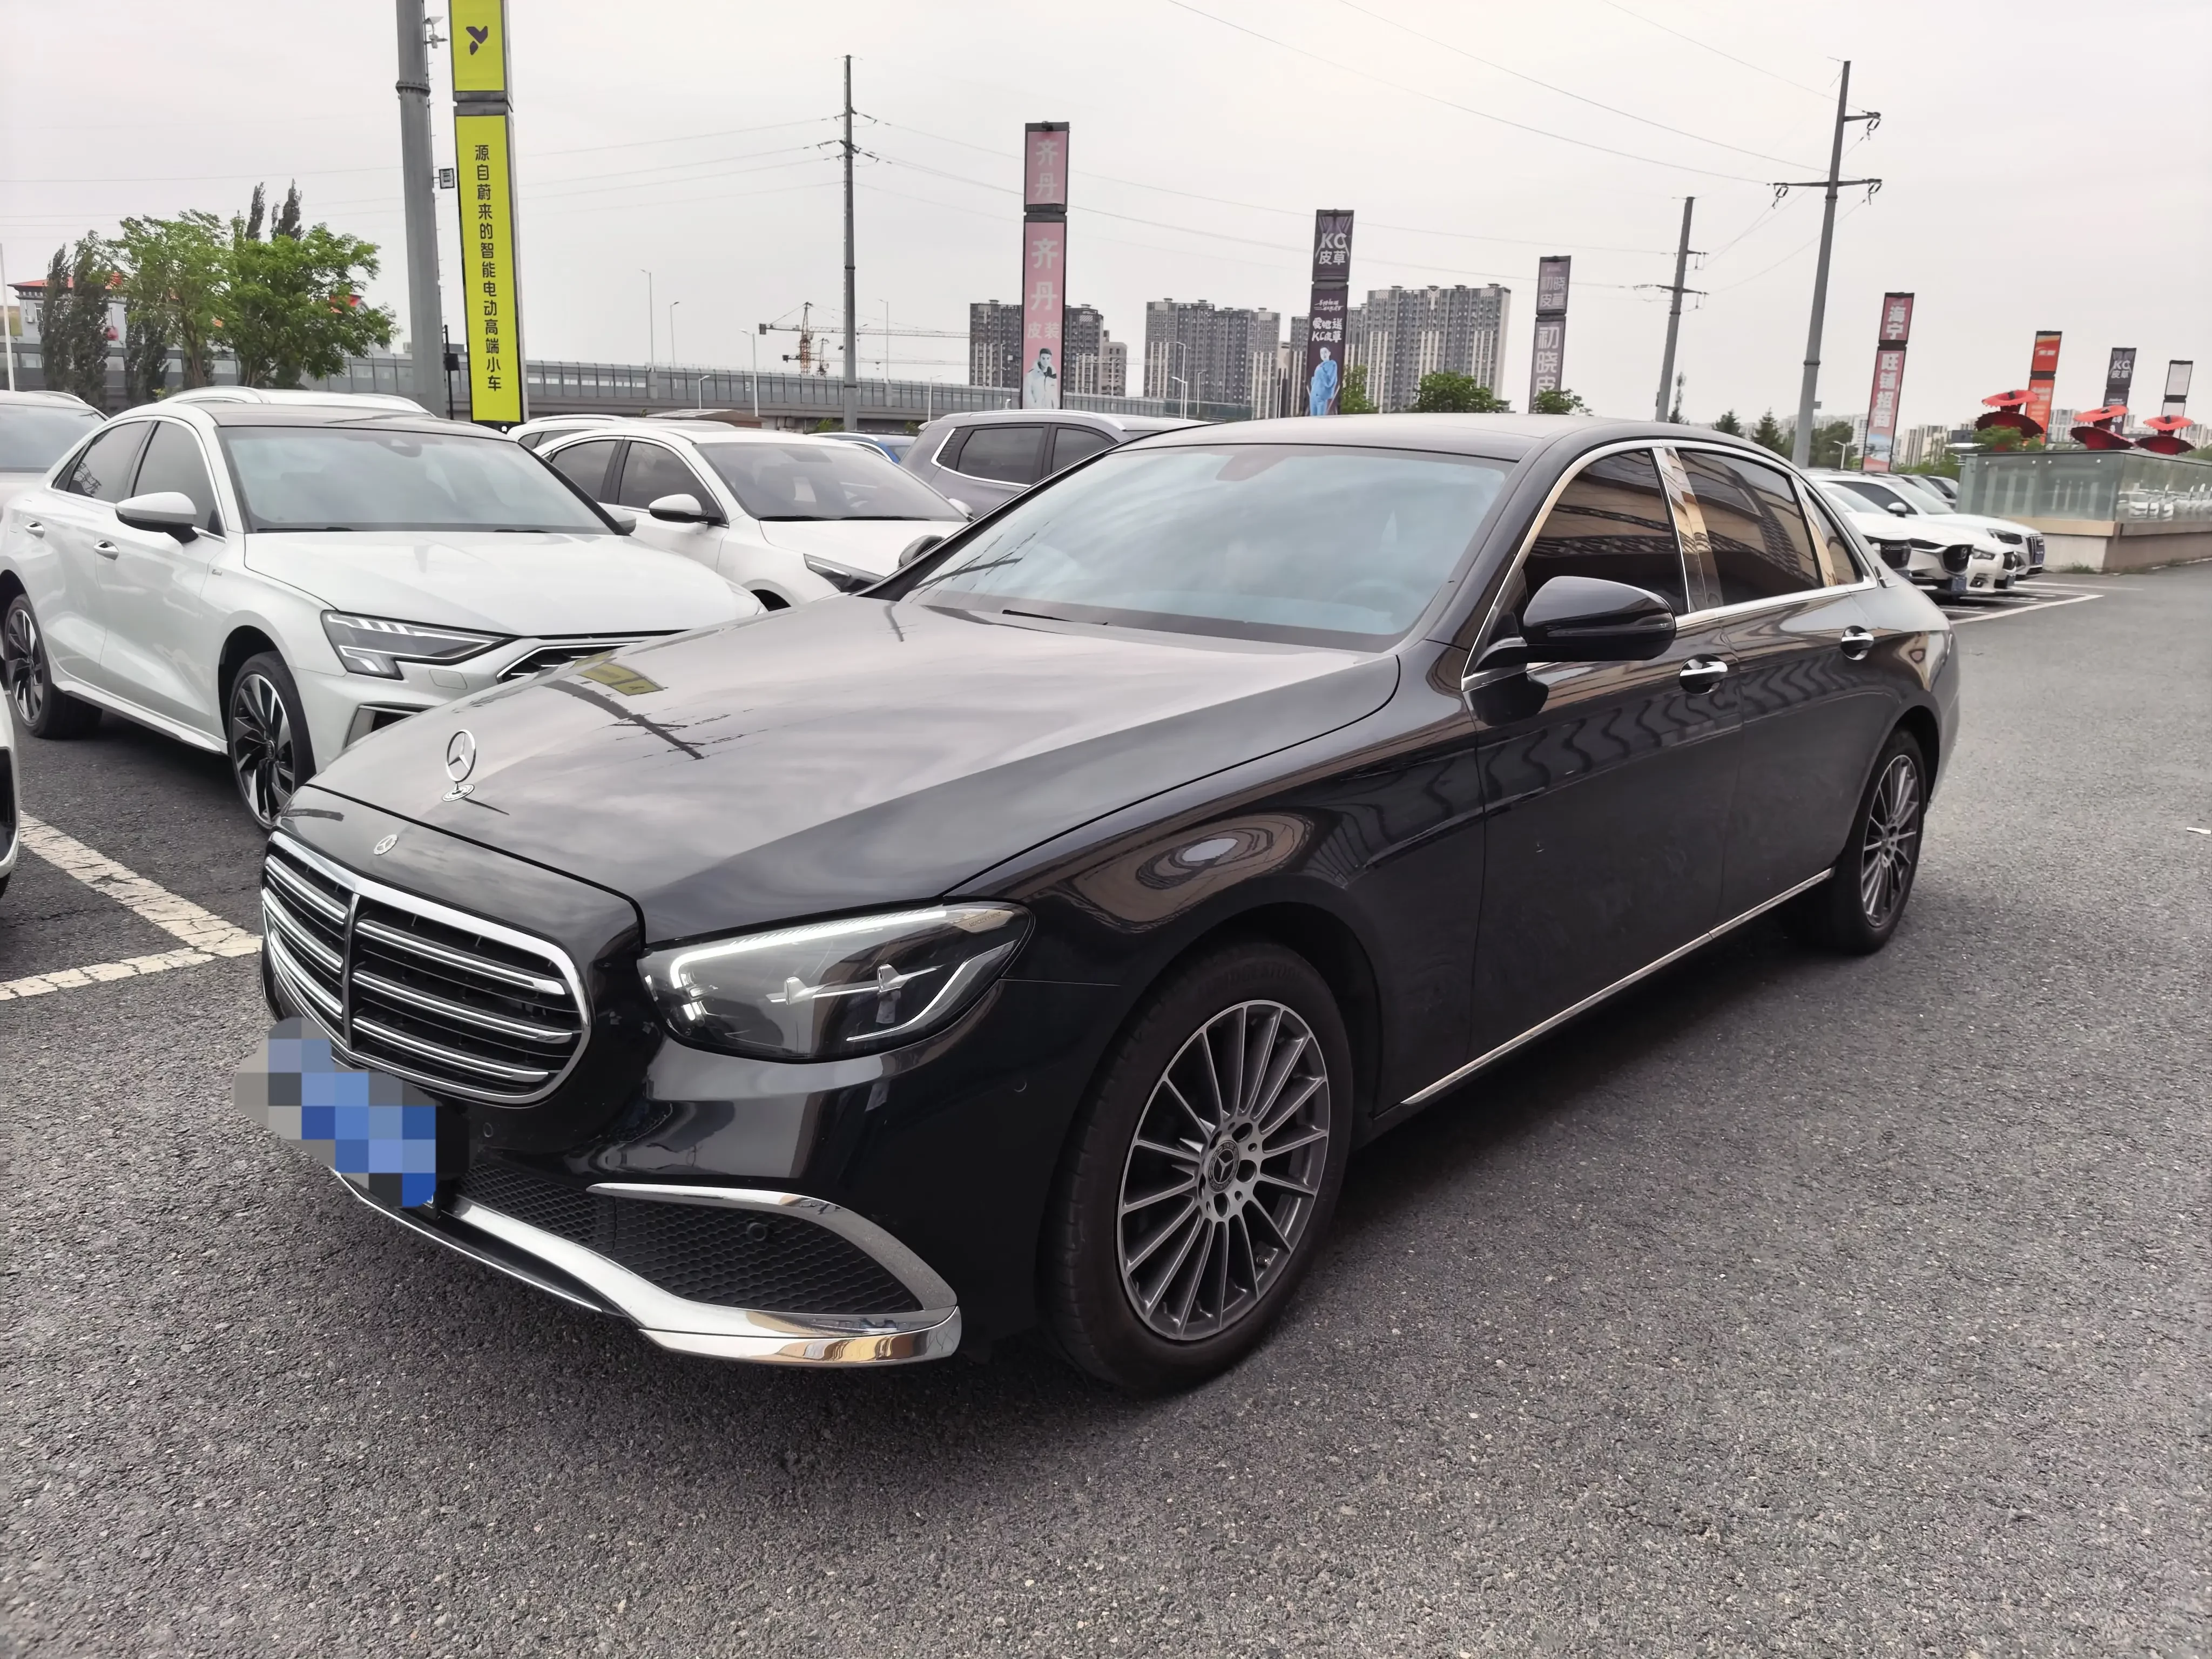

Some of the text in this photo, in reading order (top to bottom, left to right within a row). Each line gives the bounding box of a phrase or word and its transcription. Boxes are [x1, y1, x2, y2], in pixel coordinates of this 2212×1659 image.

[1034, 139, 1058, 198] 齐丹
[1319, 250, 1346, 265] 皮草
[1321, 233, 1347, 249] KC
[475, 145, 502, 392] 源自蔚来的智能电动高端小车
[1030, 238, 1058, 311] 齐丹
[1886, 306, 1906, 340] 海宁
[2113, 360, 2130, 370] KC
